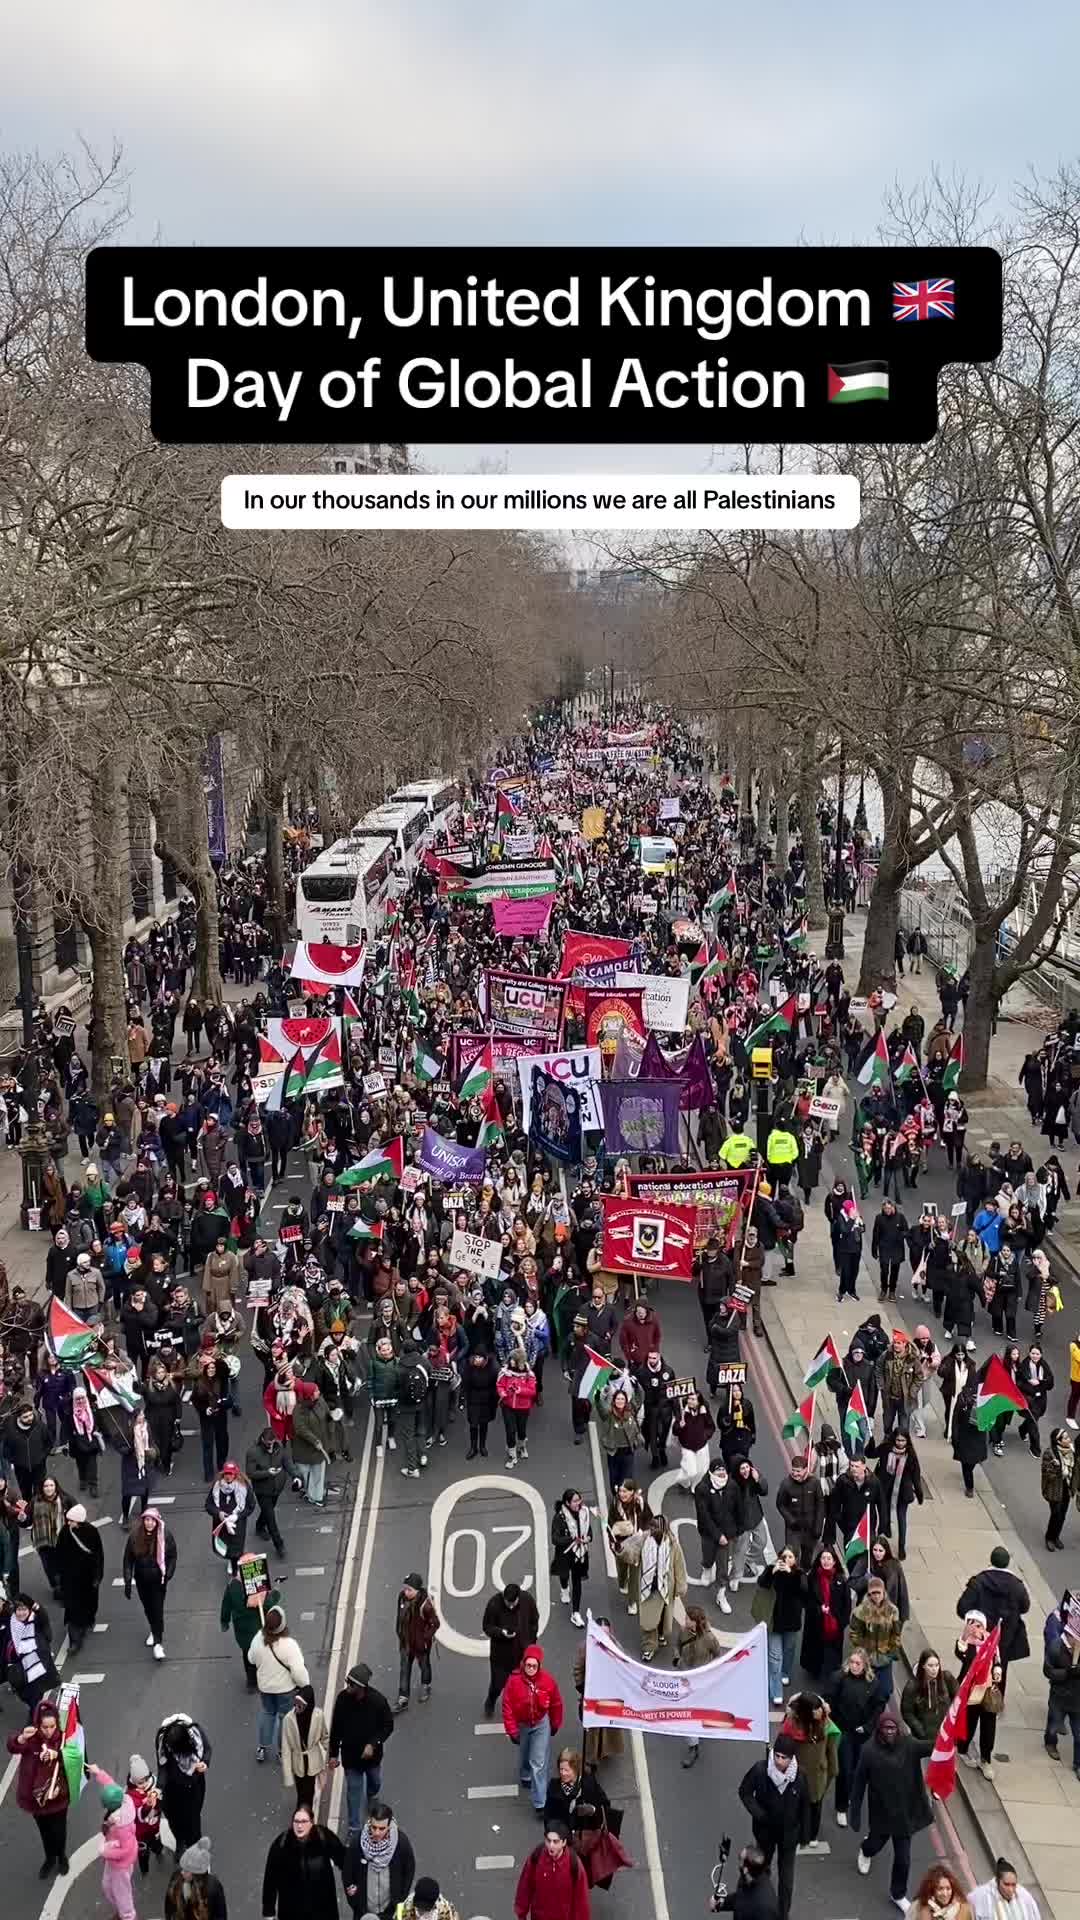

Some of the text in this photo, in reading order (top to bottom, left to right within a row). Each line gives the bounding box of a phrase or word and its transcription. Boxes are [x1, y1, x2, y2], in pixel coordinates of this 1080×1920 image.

[507, 989, 545, 1009] UCU
[433, 1083, 450, 1091] GAZA
[812, 1099, 838, 1111] Gaza
[638, 1178, 739, 1190] national education union
[442, 1197, 464, 1209] GAZA
[464, 1234, 491, 1250] STOP
[466, 1246, 483, 1257] THE
[719, 1368, 746, 1384] GAZA
[666, 1381, 696, 1398] GAZA
[652, 1680, 679, 1688] SLOUGH
